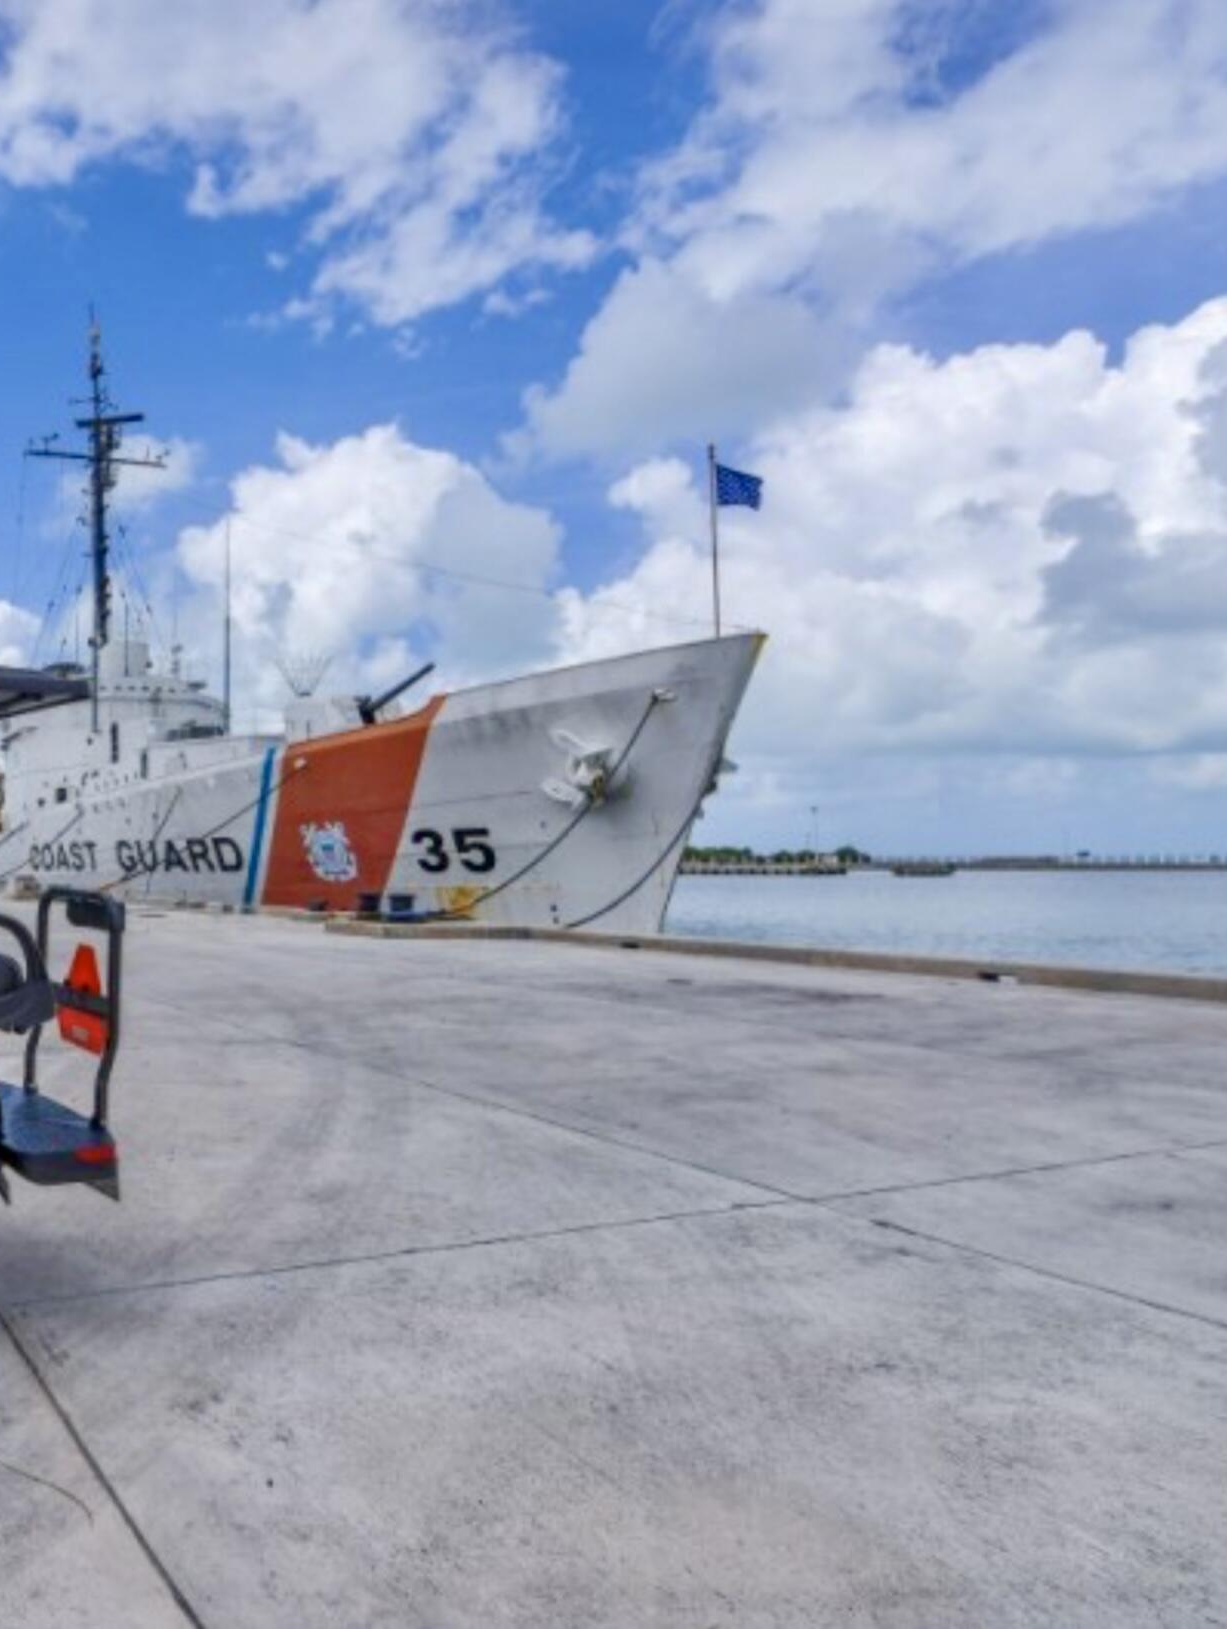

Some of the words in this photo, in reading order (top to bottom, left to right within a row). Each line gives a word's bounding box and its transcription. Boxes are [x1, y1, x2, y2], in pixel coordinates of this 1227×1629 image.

[28, 841, 98, 872] COAST
[115, 836, 245, 873] GUARD
[411, 827, 496, 874] 35
